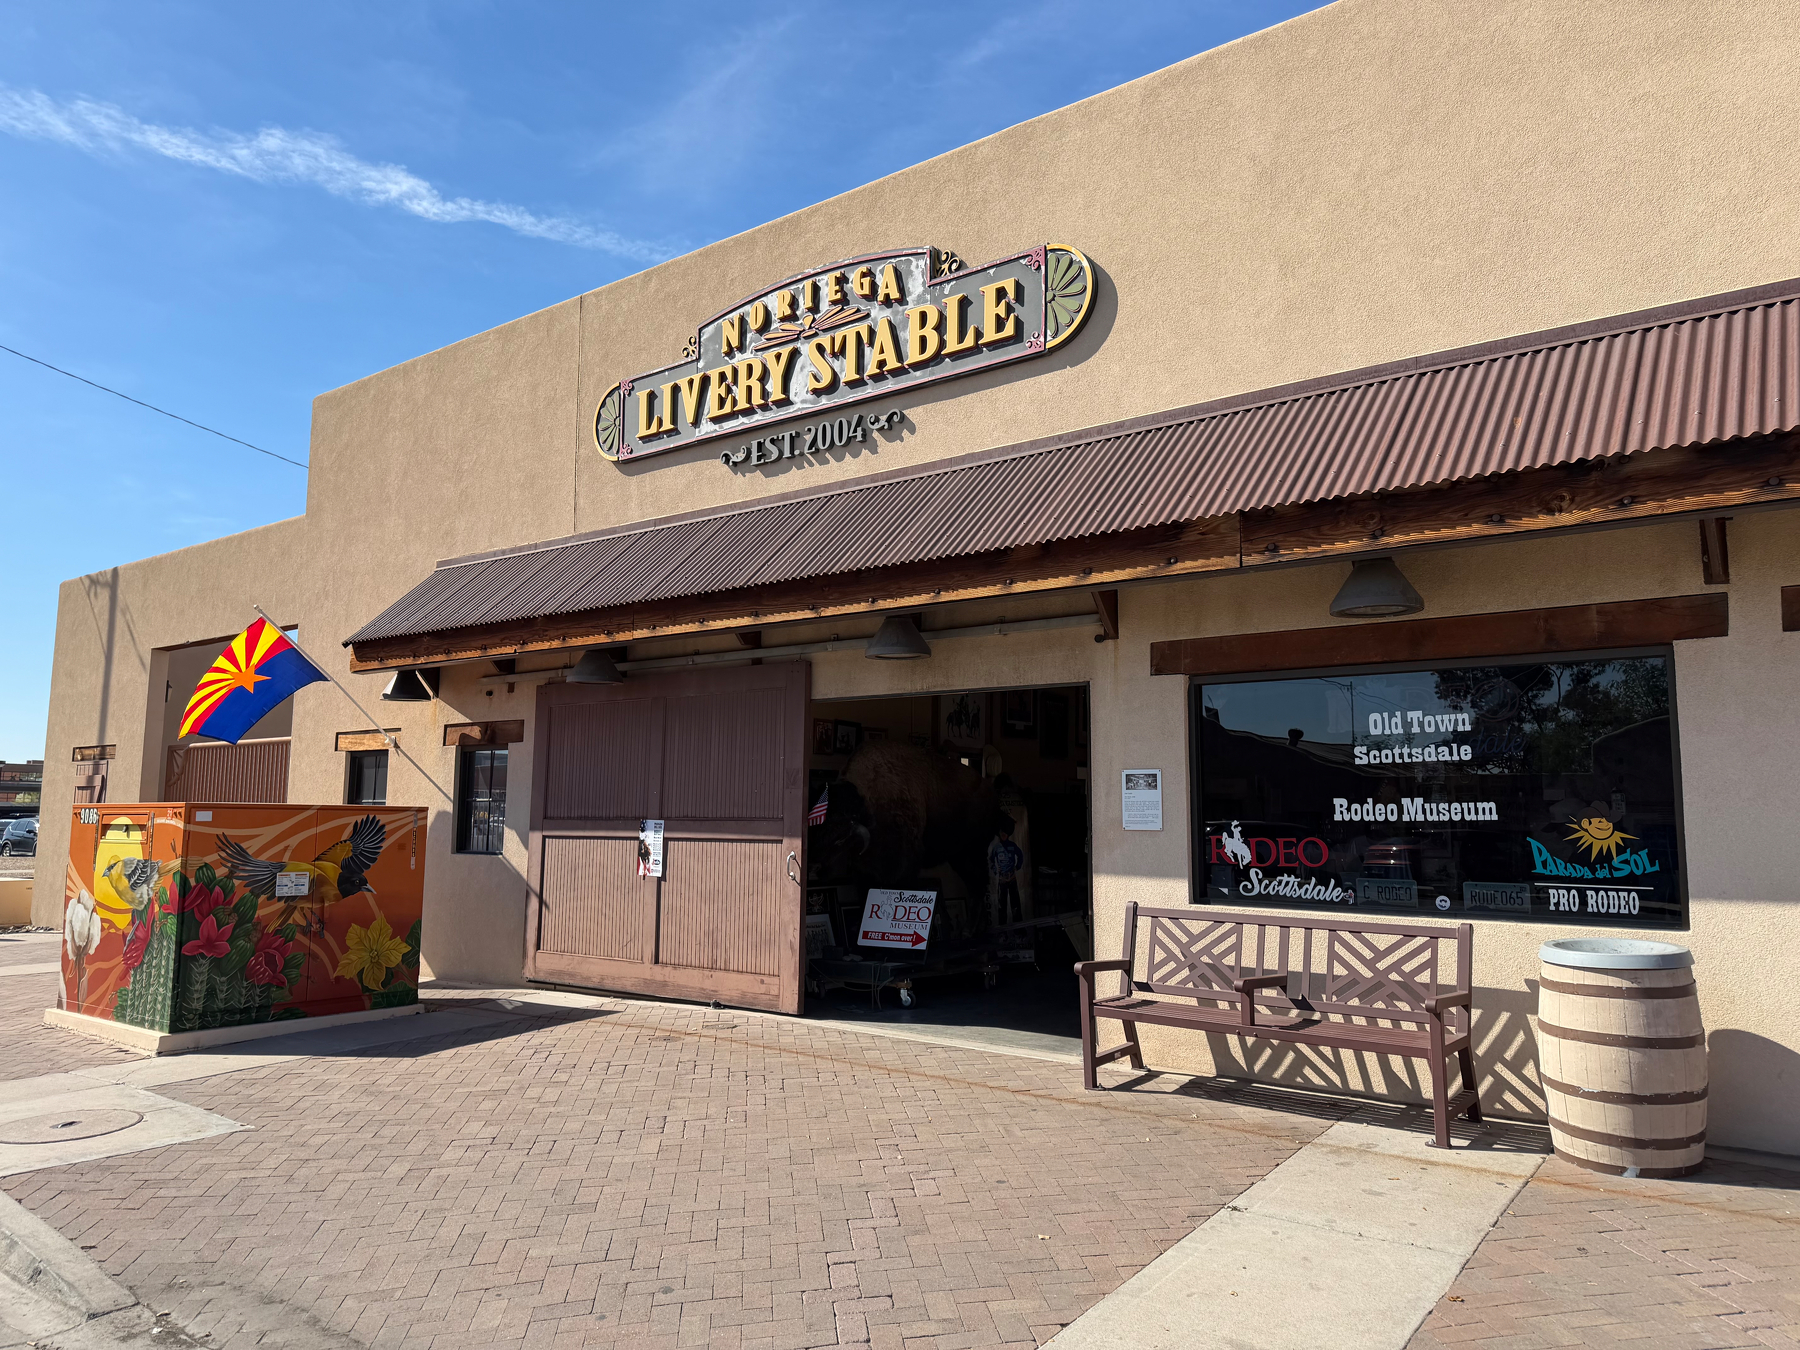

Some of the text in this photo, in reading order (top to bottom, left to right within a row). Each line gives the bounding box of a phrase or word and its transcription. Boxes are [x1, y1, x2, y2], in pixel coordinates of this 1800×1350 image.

[720, 263, 902, 357] NORIEGA
[635, 277, 1020, 440] LIVERY STABLE
[750, 414, 865, 467] EST. 2004
[1368, 710, 1472, 735] Old Town
[1353, 743, 1473, 765] Scottsdale
[80, 808, 98, 824] 9086
[1333, 797, 1498, 822] Rodeo Museum
[1209, 834, 1329, 868] RDEO
[1595, 864, 1611, 879] del
[1239, 867, 1345, 902] Scottsdale
[893, 891, 934, 904] Scottsdale
[1548, 889, 1640, 915] PRO RODEO
[868, 904, 932, 921] RDEO
[867, 932, 883, 940] FREE
[884, 932, 900, 940] C'mon
